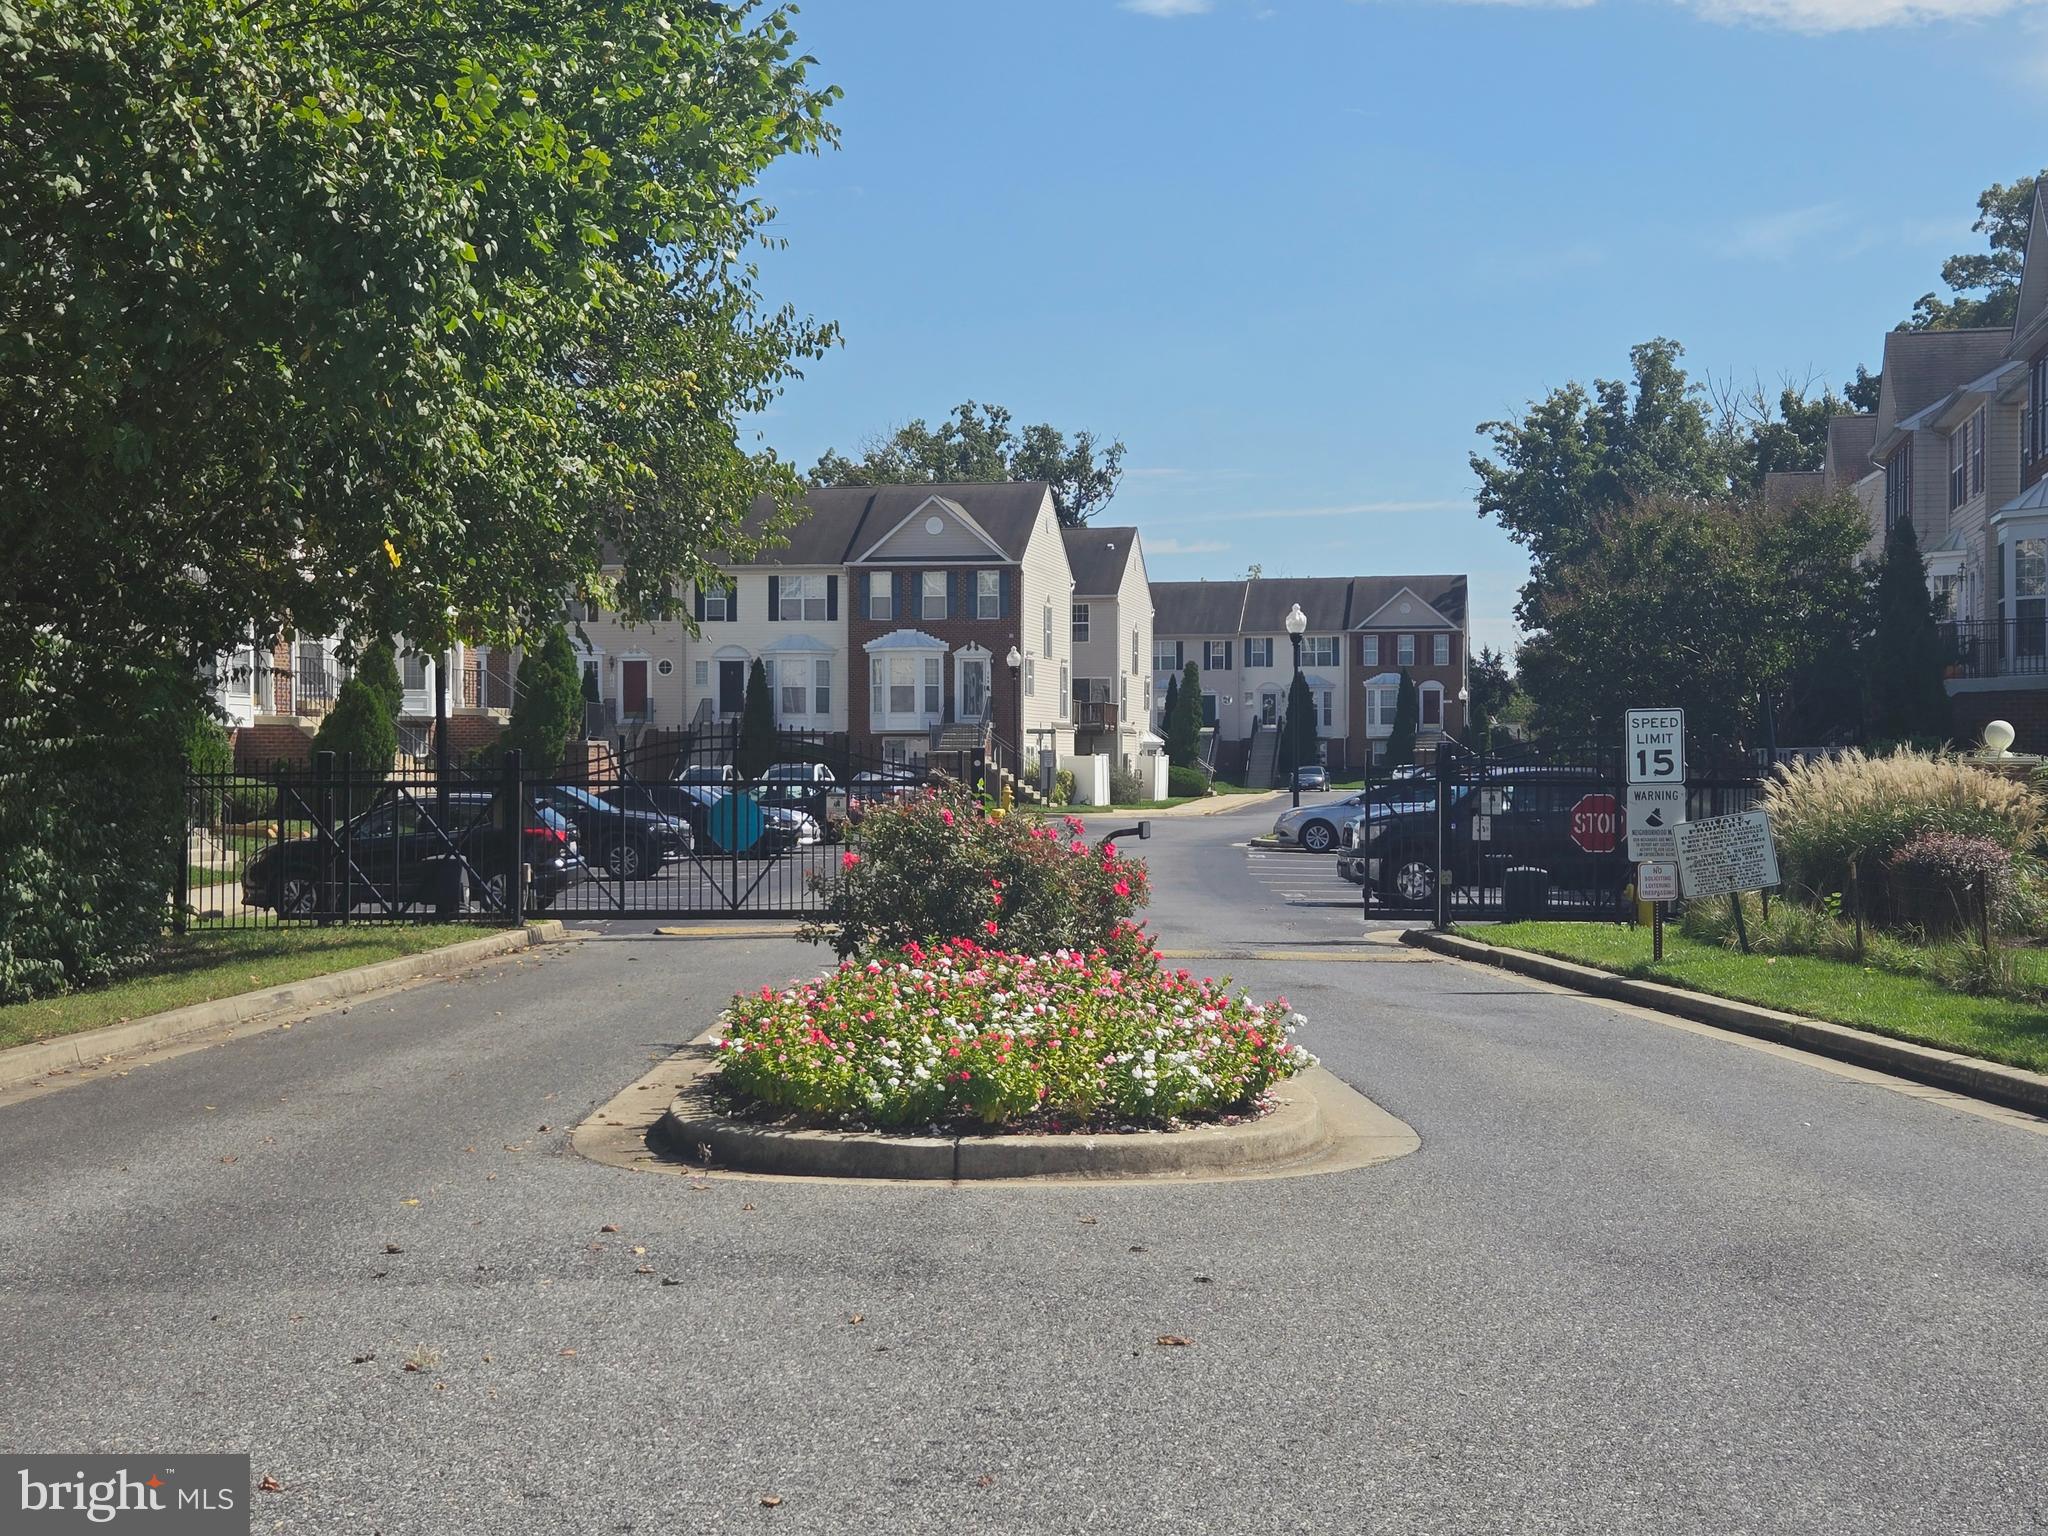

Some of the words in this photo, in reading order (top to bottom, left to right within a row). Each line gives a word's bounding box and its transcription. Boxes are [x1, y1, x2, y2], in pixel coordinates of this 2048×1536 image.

[1632, 717, 1679, 728] SPEED
[1637, 733, 1673, 744] LIMIT
[1637, 749, 1674, 776] 15
[1634, 790, 1679, 801] WARNING
[1689, 820, 1752, 834] PROPERTY
[1694, 817, 1743, 828] PRIVATE
